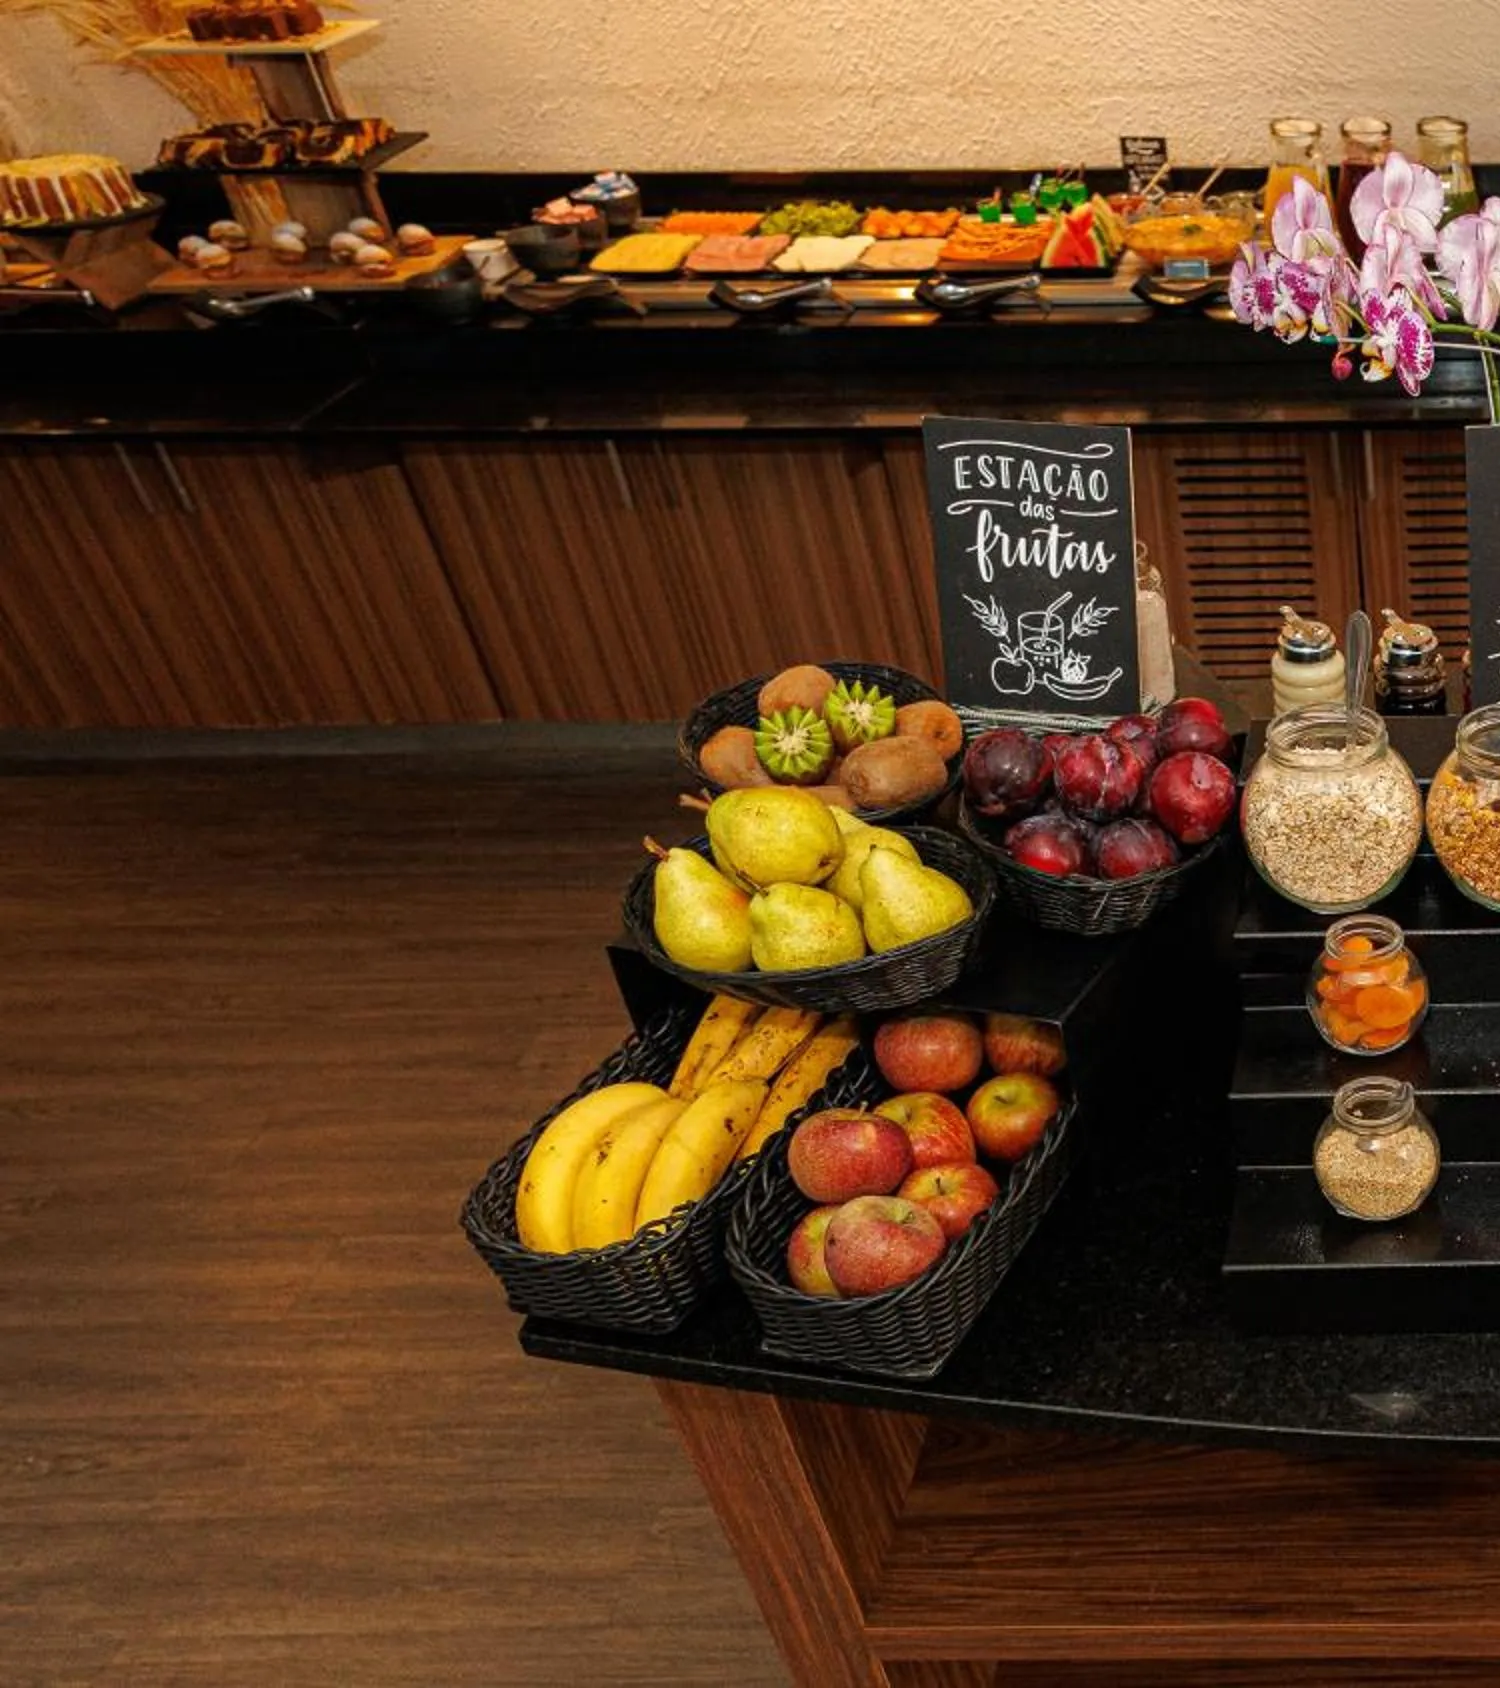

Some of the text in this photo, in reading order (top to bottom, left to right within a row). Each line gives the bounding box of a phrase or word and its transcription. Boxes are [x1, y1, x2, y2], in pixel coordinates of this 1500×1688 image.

[954, 454, 1109, 501] ESTAÇÃO
[1019, 494, 1055, 521] das
[967, 508, 1117, 583] frutas
